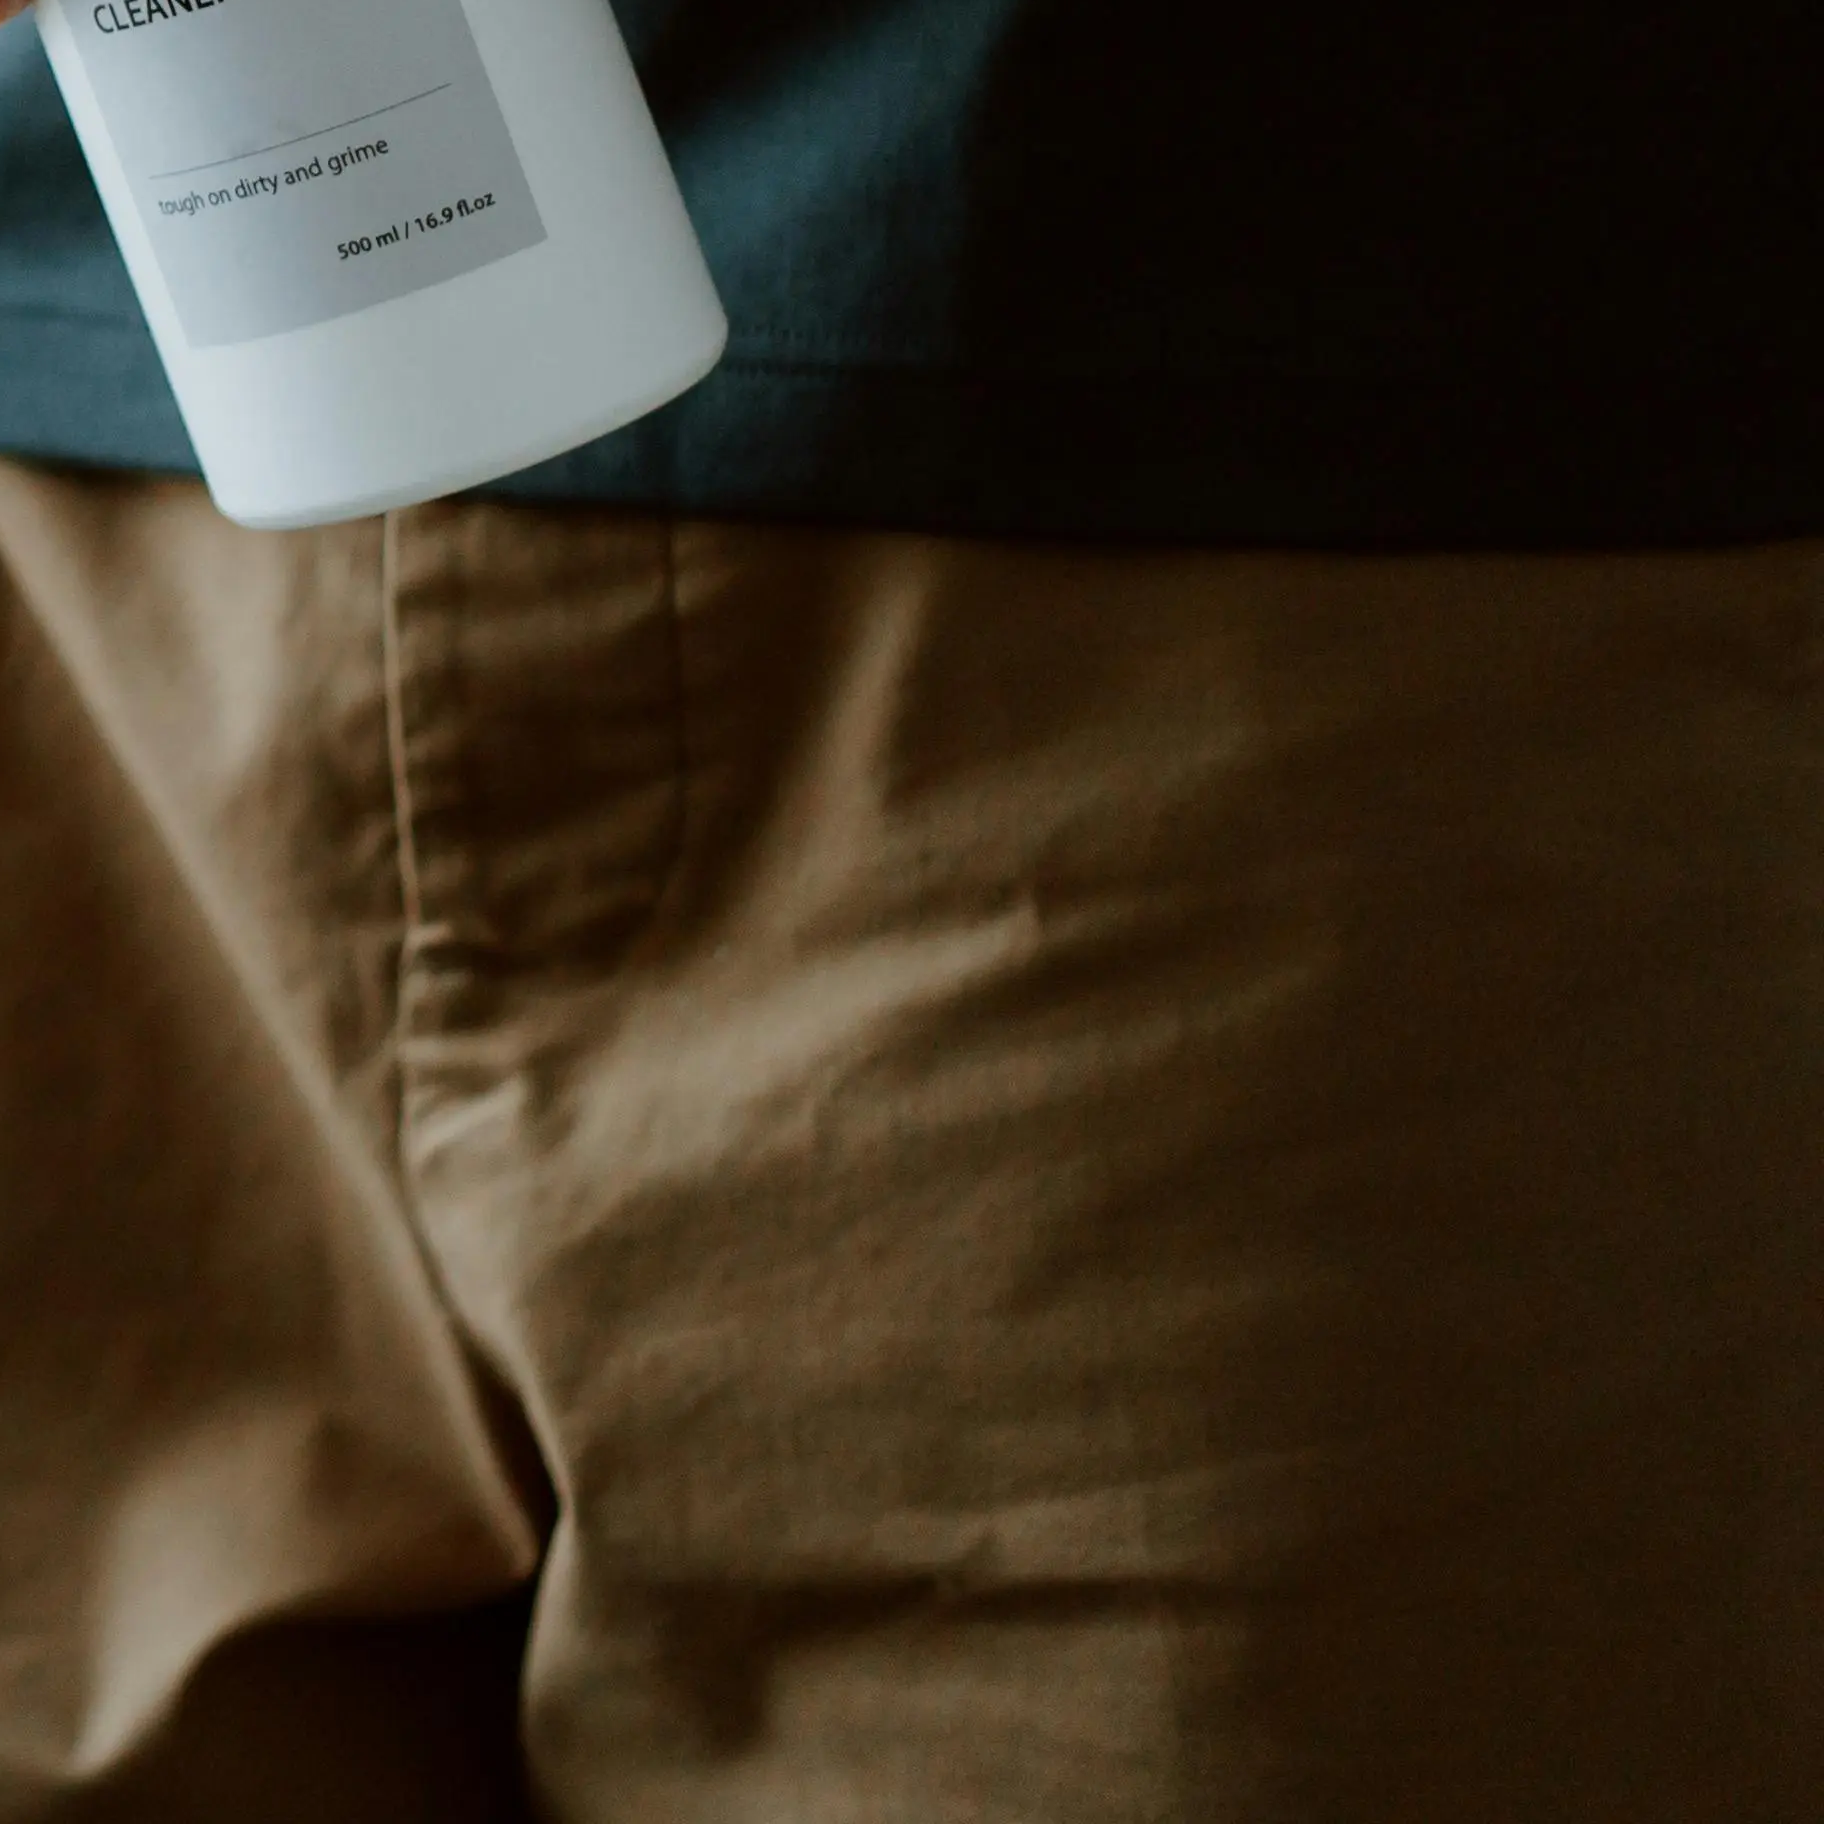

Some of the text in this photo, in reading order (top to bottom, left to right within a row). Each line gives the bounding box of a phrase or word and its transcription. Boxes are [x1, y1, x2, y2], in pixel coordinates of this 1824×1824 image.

[157, 139, 389, 217] tough on dirty and grime
[336, 236, 373, 261] 500
[375, 224, 401, 249] ml
[404, 220, 411, 240] /
[414, 206, 454, 233] 16.9
